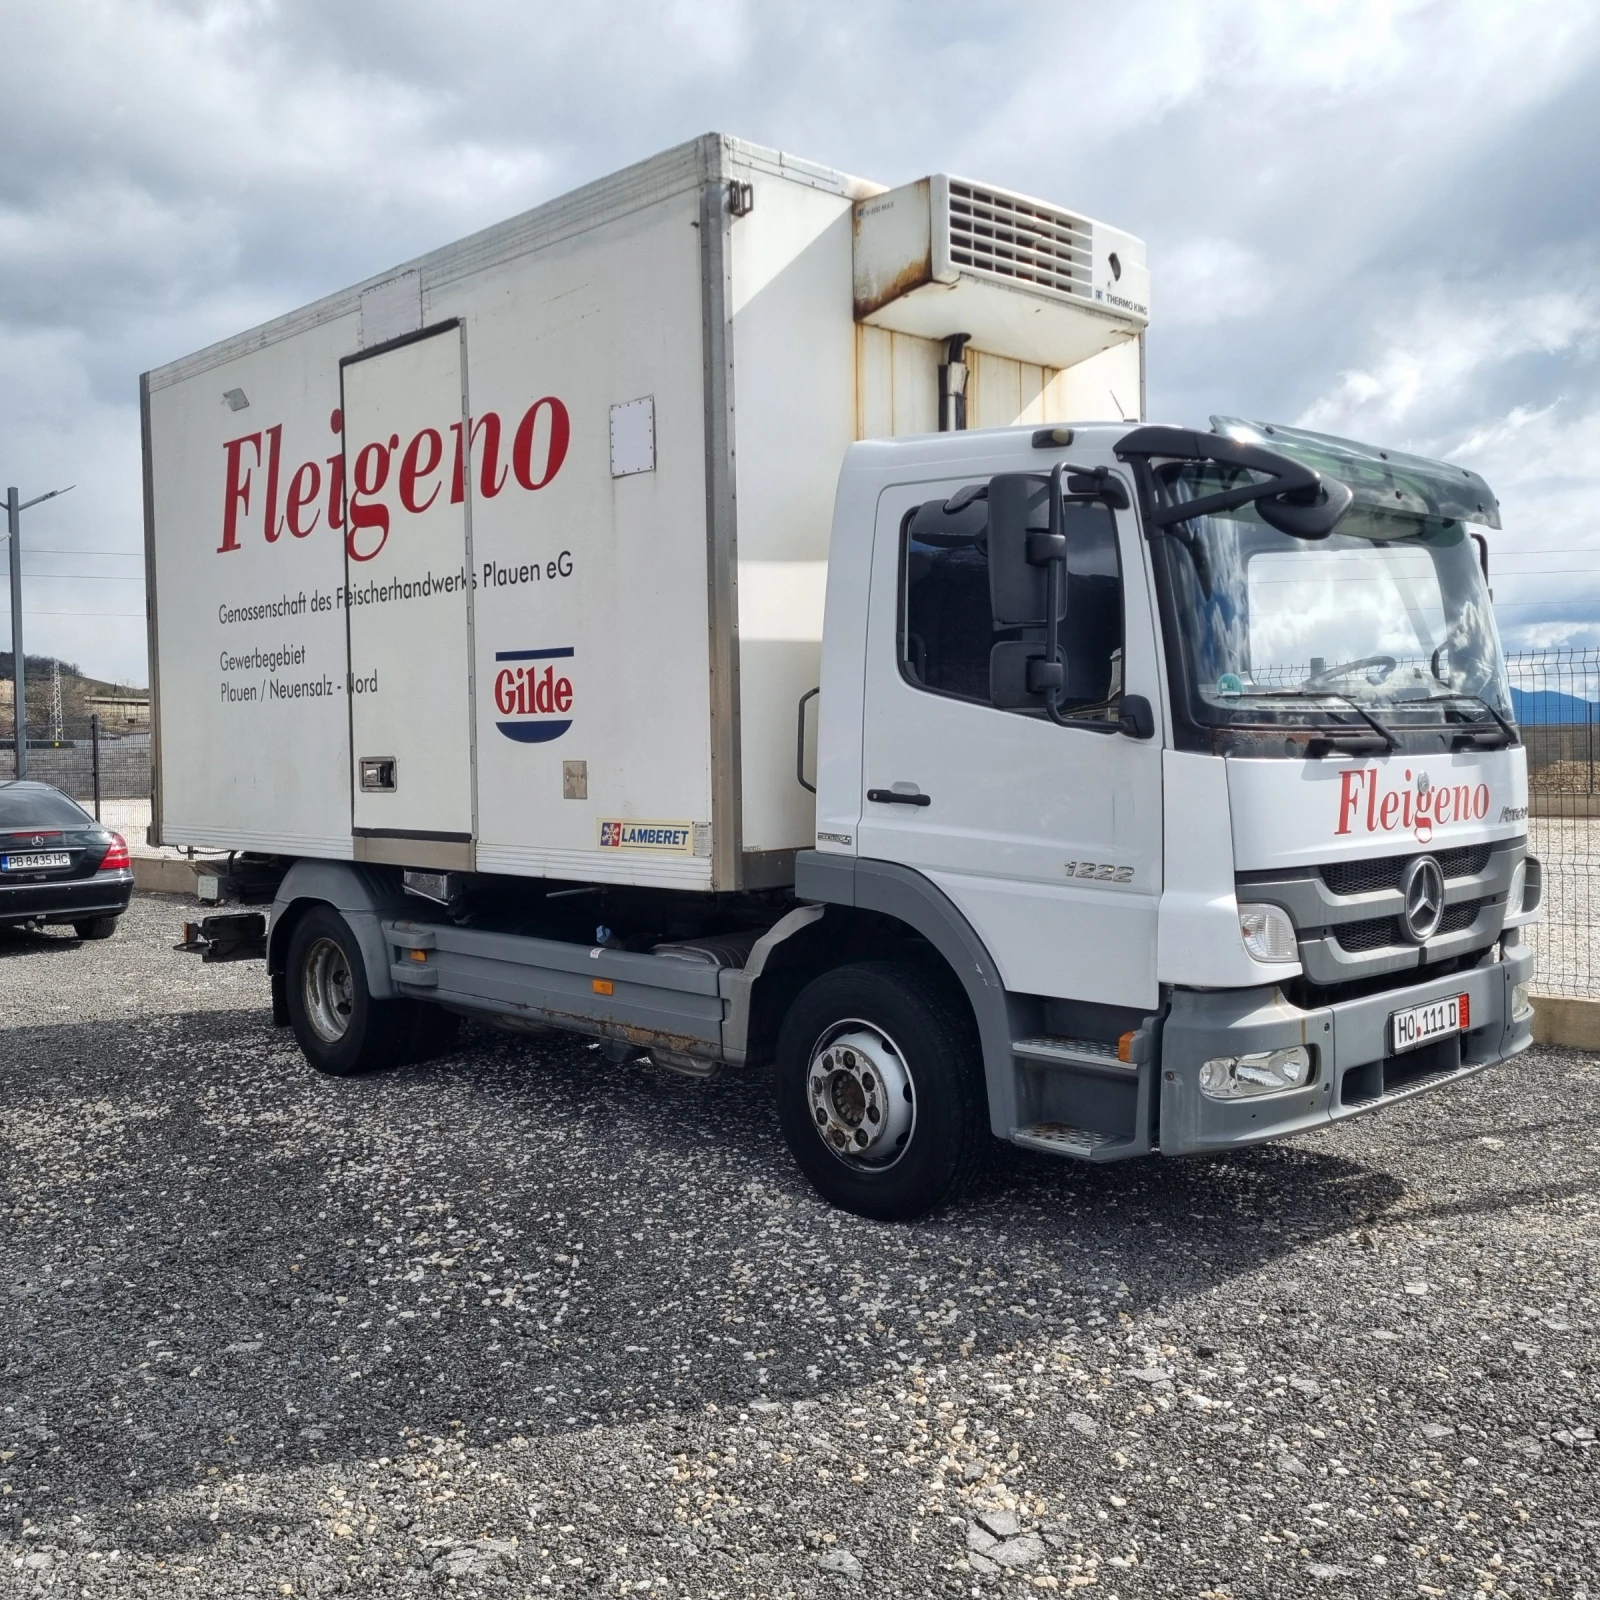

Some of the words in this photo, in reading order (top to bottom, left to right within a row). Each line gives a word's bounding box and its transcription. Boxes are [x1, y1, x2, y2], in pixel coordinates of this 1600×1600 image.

[881, 201, 895, 211] MAX
[1106, 293, 1134, 311] THERMO
[1133, 302, 1148, 316] KING
[217, 396, 571, 562] Fleigeno
[218, 591, 307, 624] Genossenschaft
[310, 589, 332, 612] des
[336, 565, 478, 609] Fleischerhandwerks
[483, 560, 541, 588] Plauen
[546, 550, 574, 579] eG
[219, 643, 306, 672] Gewerbegebiet
[220, 681, 257, 702] Plauen
[269, 673, 333, 699] Neuensalz
[346, 668, 378, 695] Nord
[494, 664, 573, 715] Gilde
[1227, 677, 1235, 690] 4
[1333, 768, 1490, 844] Fleigeno
[621, 827, 689, 846] LAMBERET
[9, 857, 24, 867] PB
[26, 855, 52, 866] 8435
[53, 854, 68, 865] HC
[1064, 861, 1135, 883] 1222
[1398, 1014, 1415, 1043] HO
[1422, 1005, 1446, 1036] 111
[1448, 1002, 1457, 1027] D
